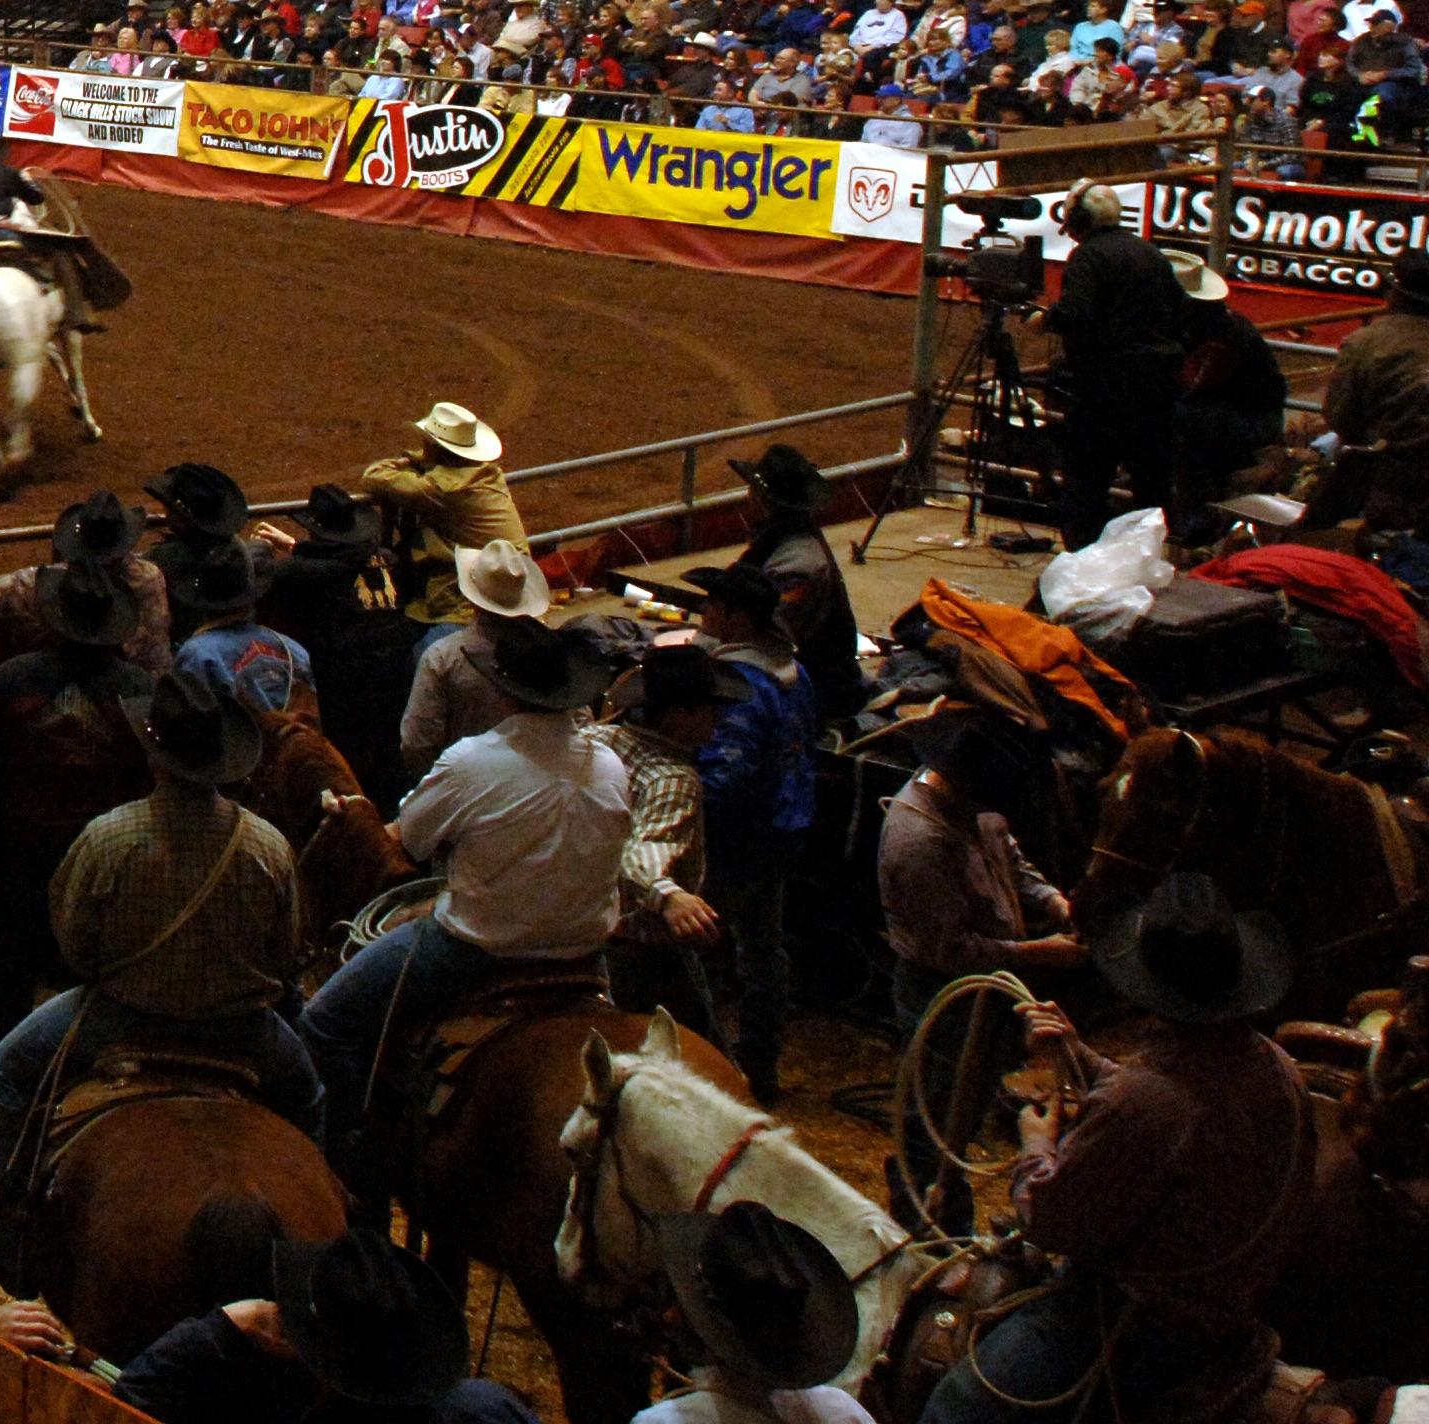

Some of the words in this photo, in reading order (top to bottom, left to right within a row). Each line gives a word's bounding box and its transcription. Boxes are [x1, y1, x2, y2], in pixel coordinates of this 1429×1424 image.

[16, 85, 53, 105] Coca-Cola
[83, 82, 126, 101] WELCOME
[128, 87, 139, 102] TO
[142, 88, 158, 103] THE
[62, 100, 89, 117] BLACK
[91, 103, 114, 121] HILLS
[115, 107, 144, 124] STOCK
[147, 108, 175, 126] SHOW
[187, 102, 253, 134] TACO
[88, 124, 107, 140] AND
[110, 126, 143, 144] RODEO
[365, 101, 492, 187] Justin
[201, 135, 219, 146] The
[221, 139, 243, 150] Fresh
[245, 141, 267, 153] Taste
[268, 145, 278, 154] of
[281, 146, 323, 159] West-Mex
[422, 170, 464, 186] BOOTS
[598, 128, 832, 220] Wrangler
